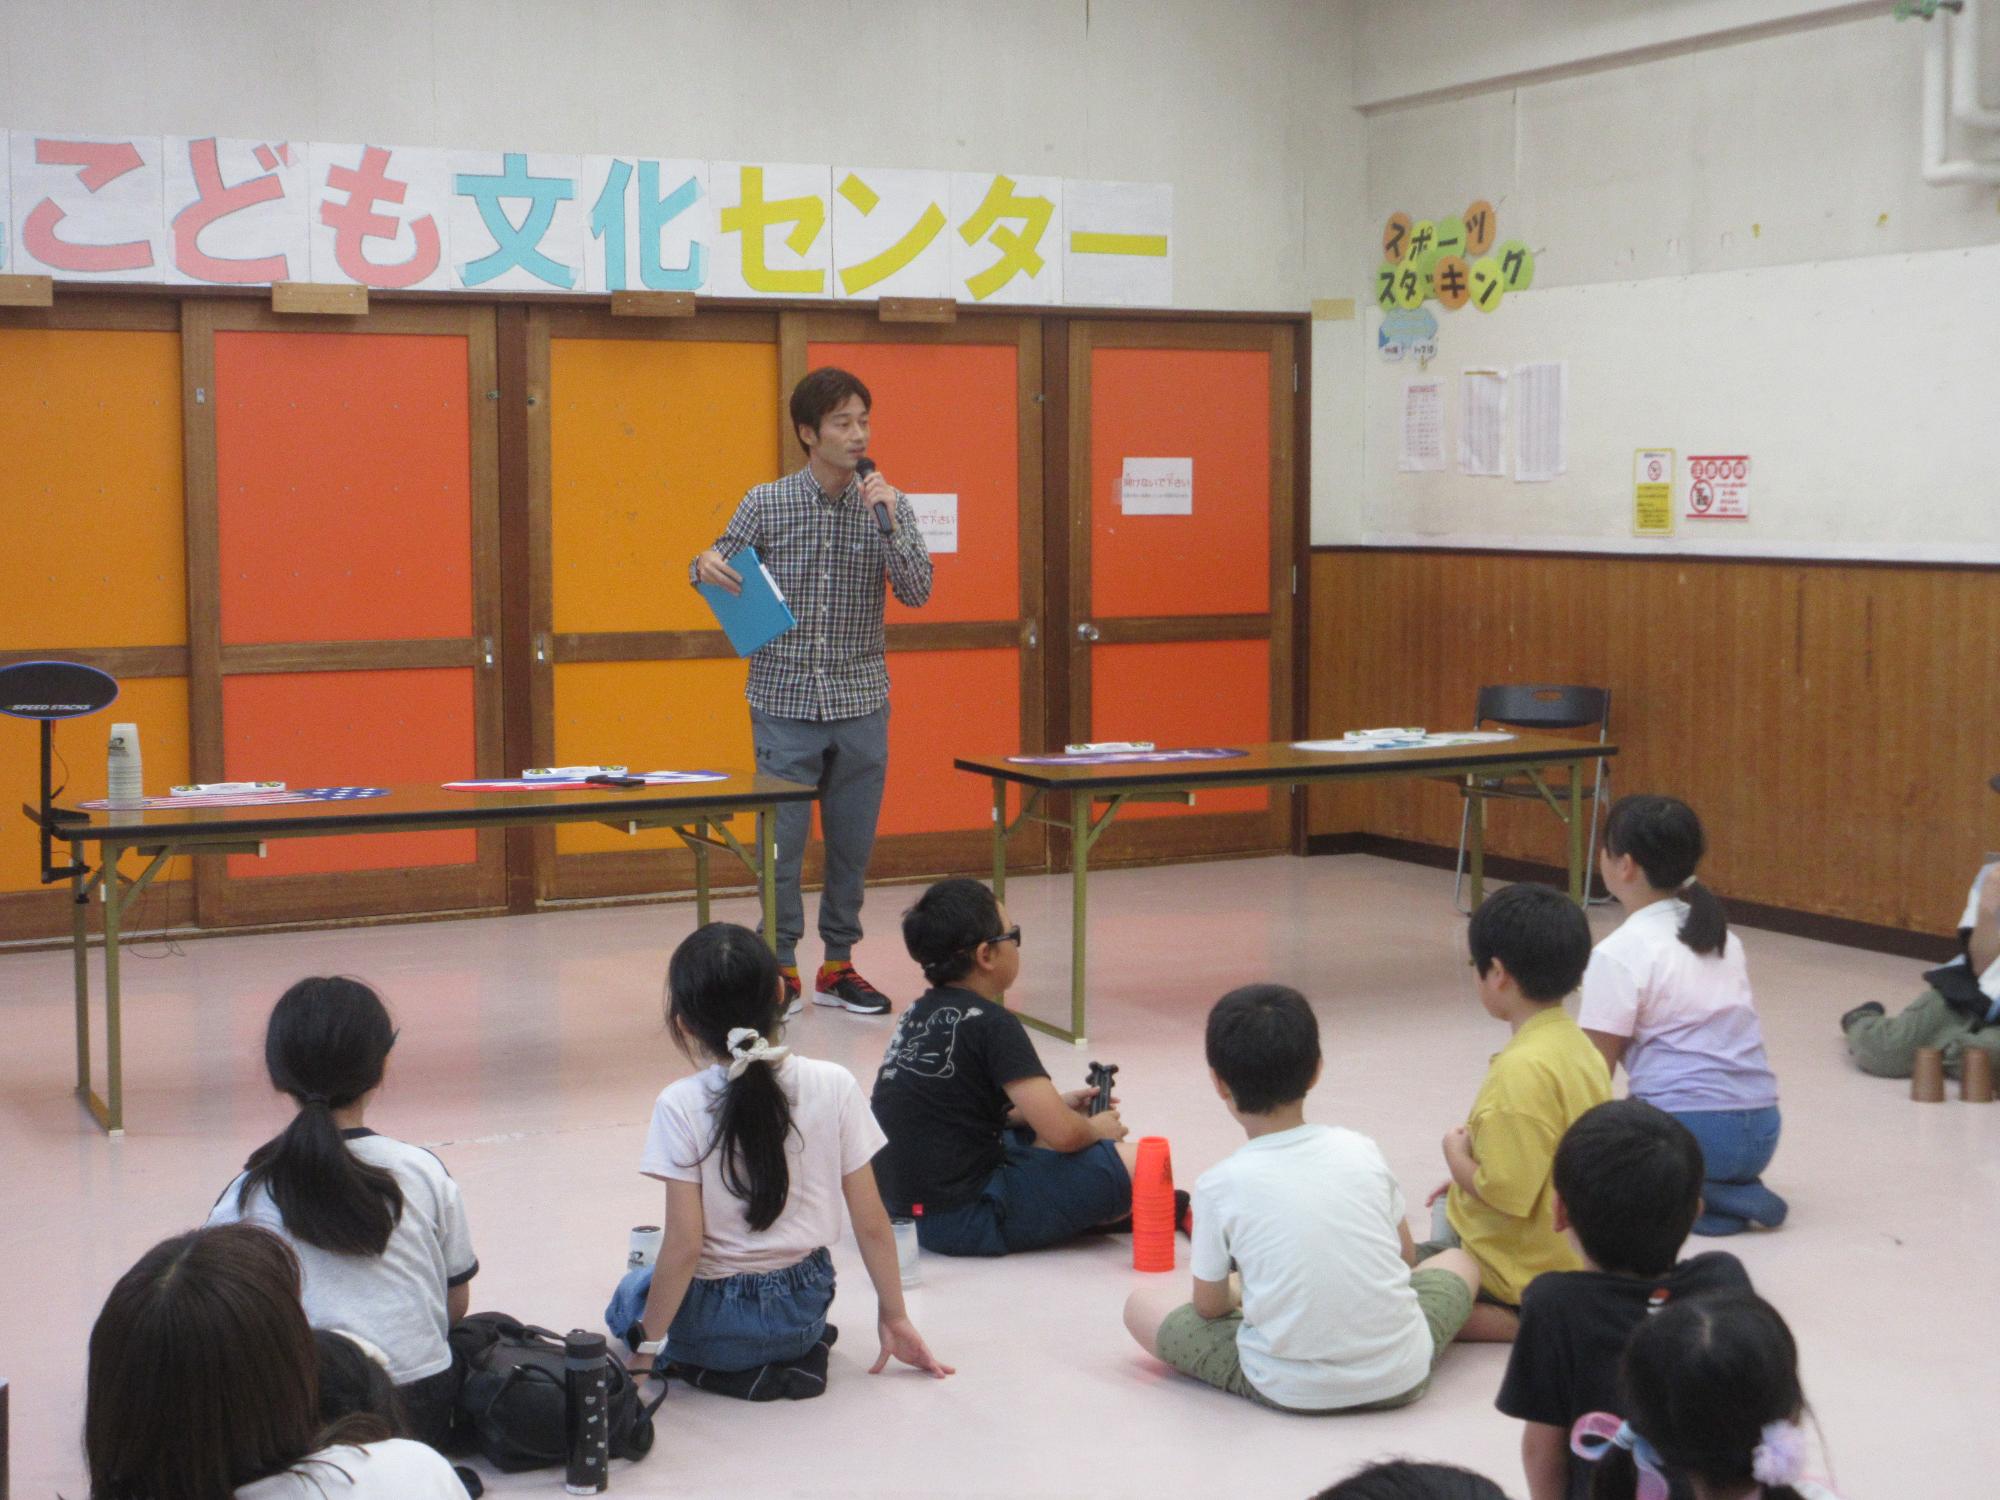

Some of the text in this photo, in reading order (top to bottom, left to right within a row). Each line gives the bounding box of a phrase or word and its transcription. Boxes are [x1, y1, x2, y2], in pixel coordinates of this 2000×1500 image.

[0, 136, 1168, 301] こども文化センター
[1385, 210, 1487, 261] スポーツ
